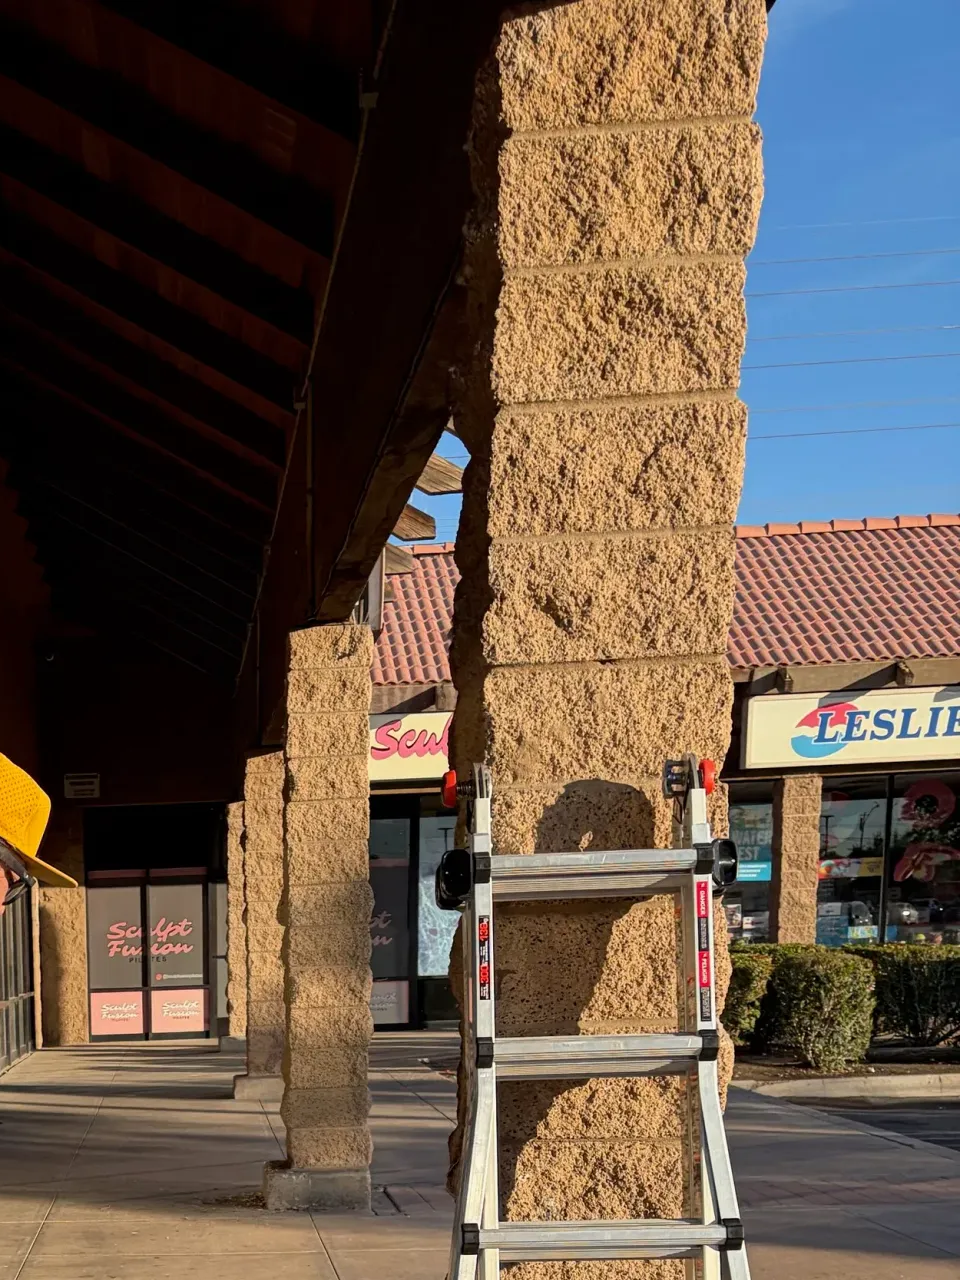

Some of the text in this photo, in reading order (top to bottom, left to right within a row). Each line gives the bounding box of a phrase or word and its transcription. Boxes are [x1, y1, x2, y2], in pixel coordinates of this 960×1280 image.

[107, 937, 194, 957] Fuion
[101, 1002, 138, 1012] Sculpt
[162, 1000, 199, 1010] Sculpt
